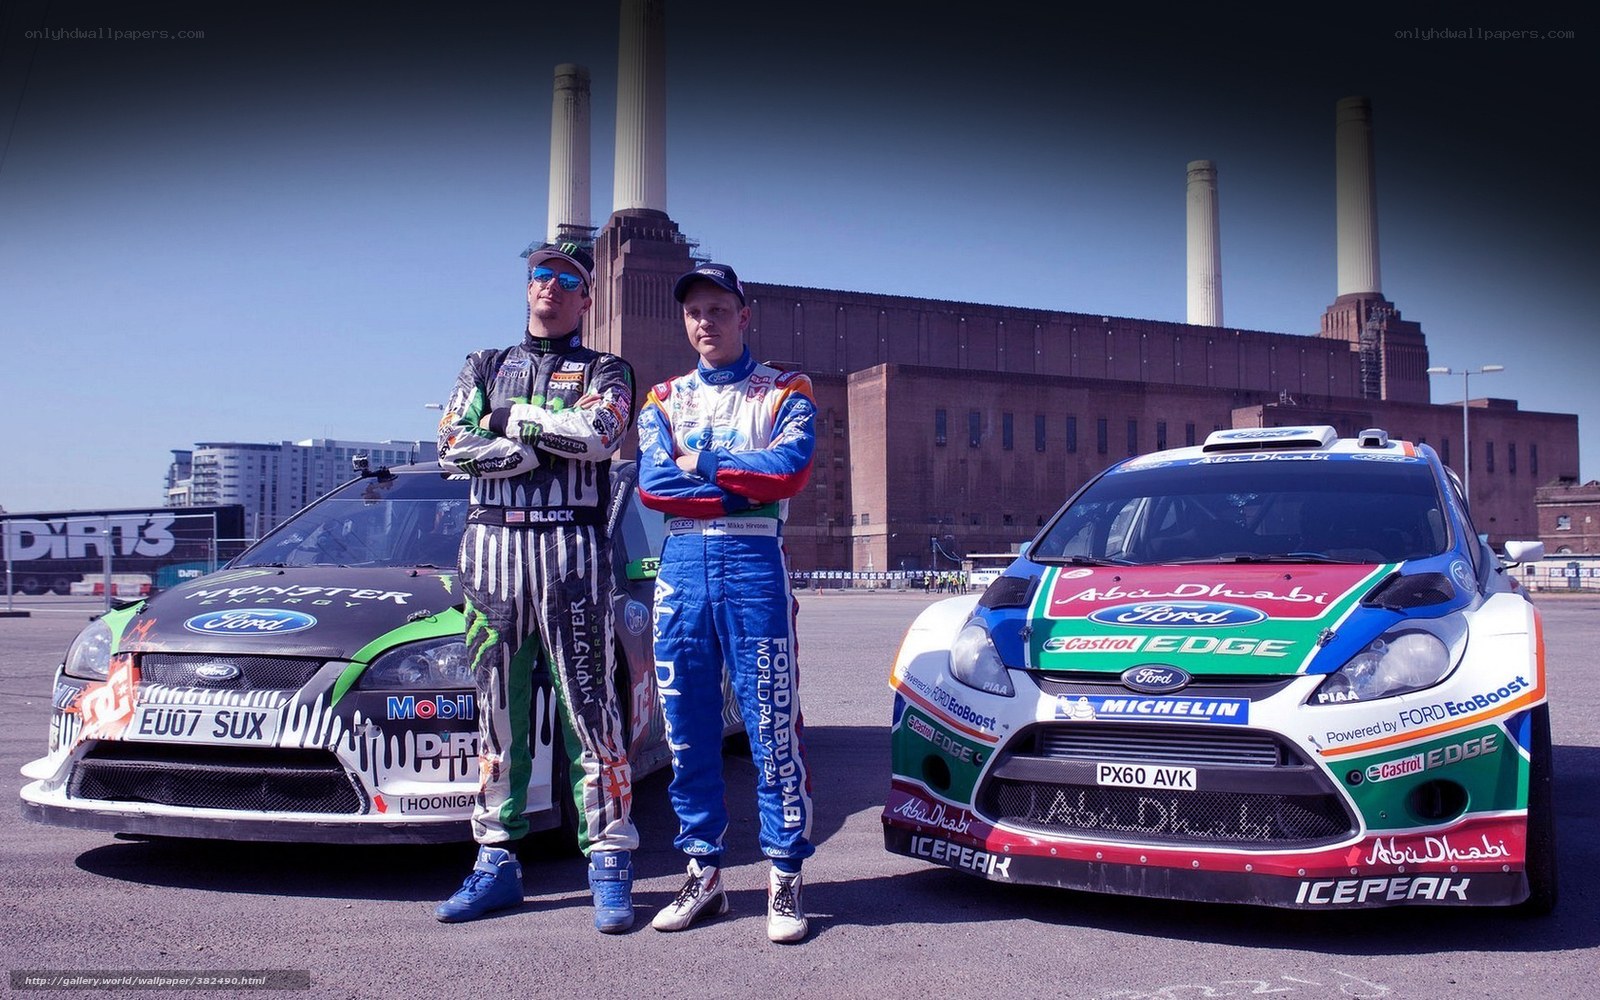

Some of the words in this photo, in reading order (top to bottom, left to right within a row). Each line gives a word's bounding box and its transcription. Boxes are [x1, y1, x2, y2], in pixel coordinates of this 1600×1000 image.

[530, 510, 574, 522] BLOCK
[185, 585, 413, 604] MONSTER
[199, 597, 362, 608] ENERGY
[1055, 583, 1155, 605] Abu
[1163, 583, 1328, 605] Dhabi
[204, 610, 293, 631] Ford
[1117, 603, 1233, 625] Ford
[571, 597, 594, 704] MONSTER
[1064, 636, 1137, 650] Castrol
[1142, 635, 1297, 657] EDGE
[199, 665, 230, 676] Ford
[756, 638, 771, 701] WORLD
[773, 637, 791, 708] FORD
[1135, 668, 1173, 685] Ford
[901, 666, 926, 690] Powered
[931, 687, 949, 707] FORD
[948, 698, 996, 731] EcoBoost
[983, 682, 1007, 694] PIAA
[1318, 691, 1359, 704] PIAA
[387, 695, 474, 720] Mobil
[1100, 699, 1241, 717] MICHELIN
[1326, 723, 1381, 744] Powered
[1382, 720, 1397, 733] by
[1399, 704, 1446, 728] FORD
[1447, 675, 1530, 717] EcoBoost
[139, 708, 202, 736] EU07
[212, 710, 267, 740] SUX
[758, 703, 773, 753] RALLY
[773, 710, 789, 761] ABU
[913, 719, 933, 740] Castrol
[933, 731, 973, 762] EDGE
[1381, 756, 1422, 779] Castrol
[1426, 733, 1500, 769] EDGE
[1100, 765, 1146, 785] PX60
[1152, 769, 1192, 788] AVK
[779, 760, 801, 829] DHABI
[894, 798, 930, 822] Abu
[930, 804, 972, 834] Dhabi
[1038, 790, 1125, 830] Abu
[1136, 797, 1273, 841] Dhabi
[686, 843, 708, 853] Ford
[910, 835, 1012, 878] ICEPEAK
[1366, 837, 1421, 865] Abu
[1424, 834, 1511, 862] Dhabi
[1295, 877, 1471, 904] ICEPEAK
